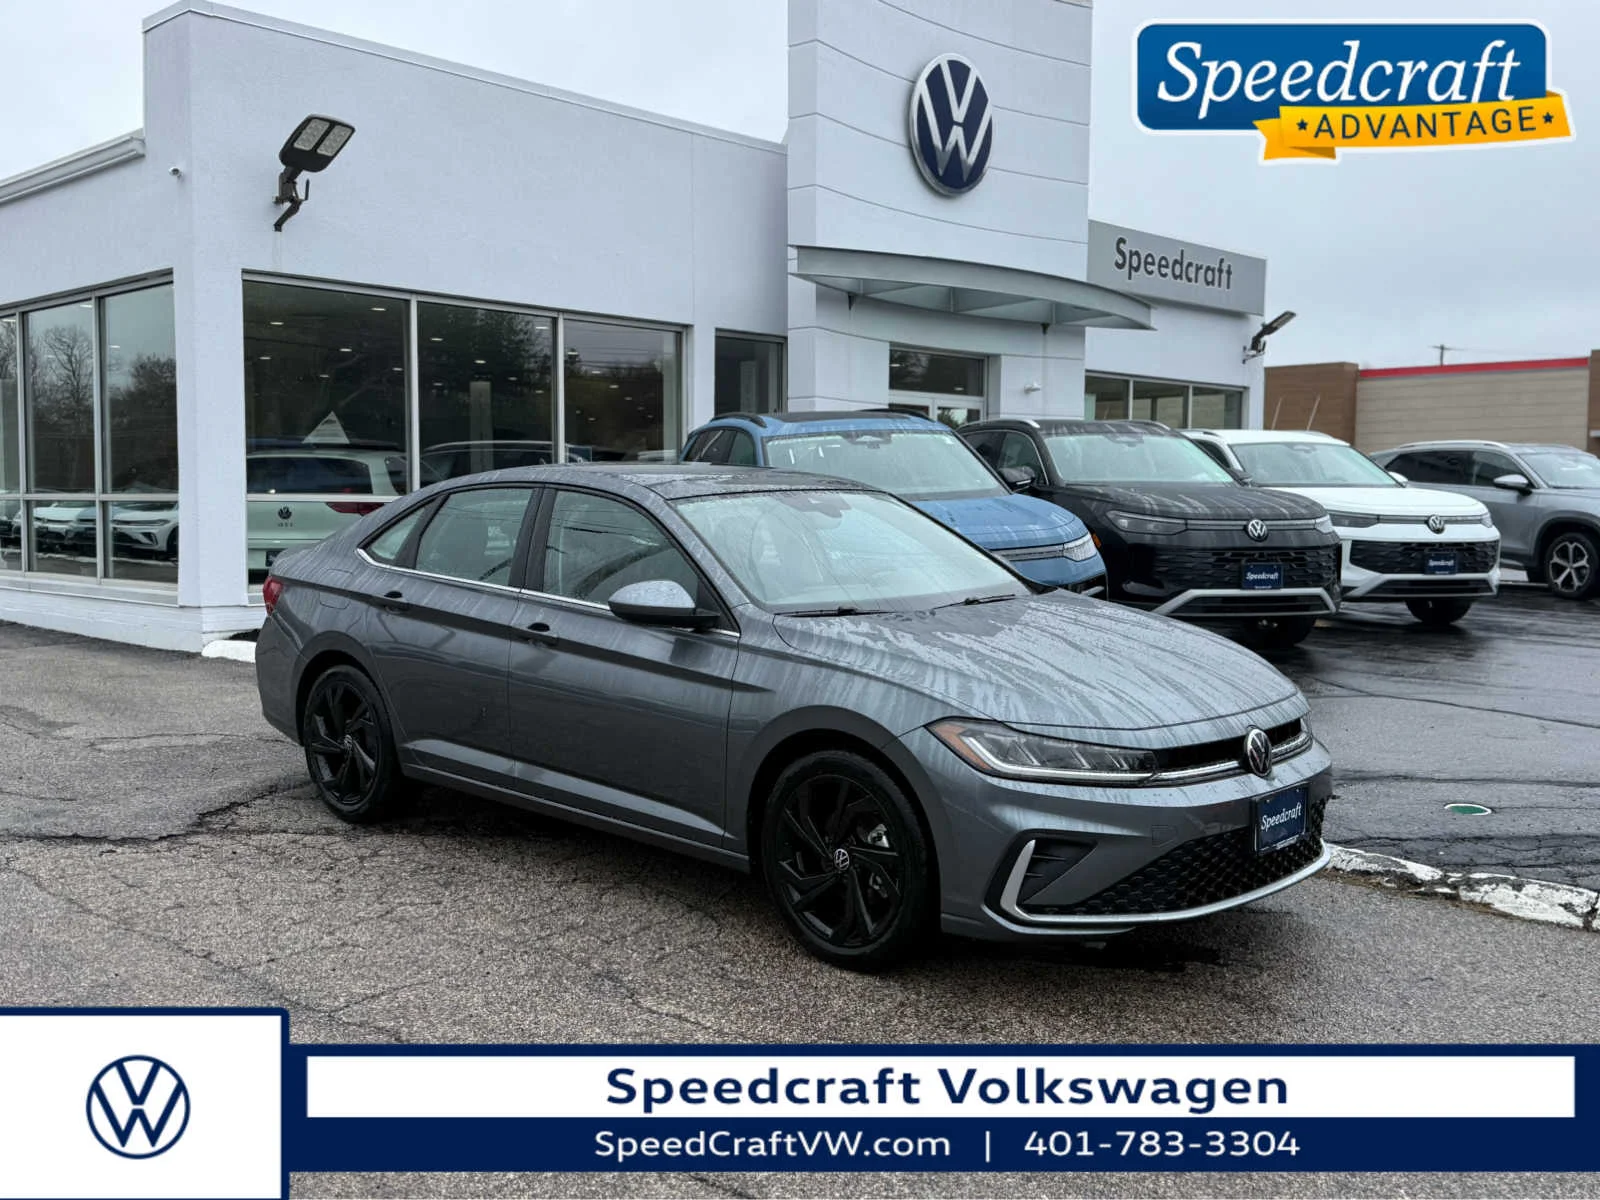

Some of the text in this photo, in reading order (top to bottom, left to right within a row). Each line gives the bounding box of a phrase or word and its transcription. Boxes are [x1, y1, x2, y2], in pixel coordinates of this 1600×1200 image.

[909, 52, 993, 197] VW
[1114, 236, 1233, 290] Speedcraft
[1261, 802, 1302, 832] Speedcraft
